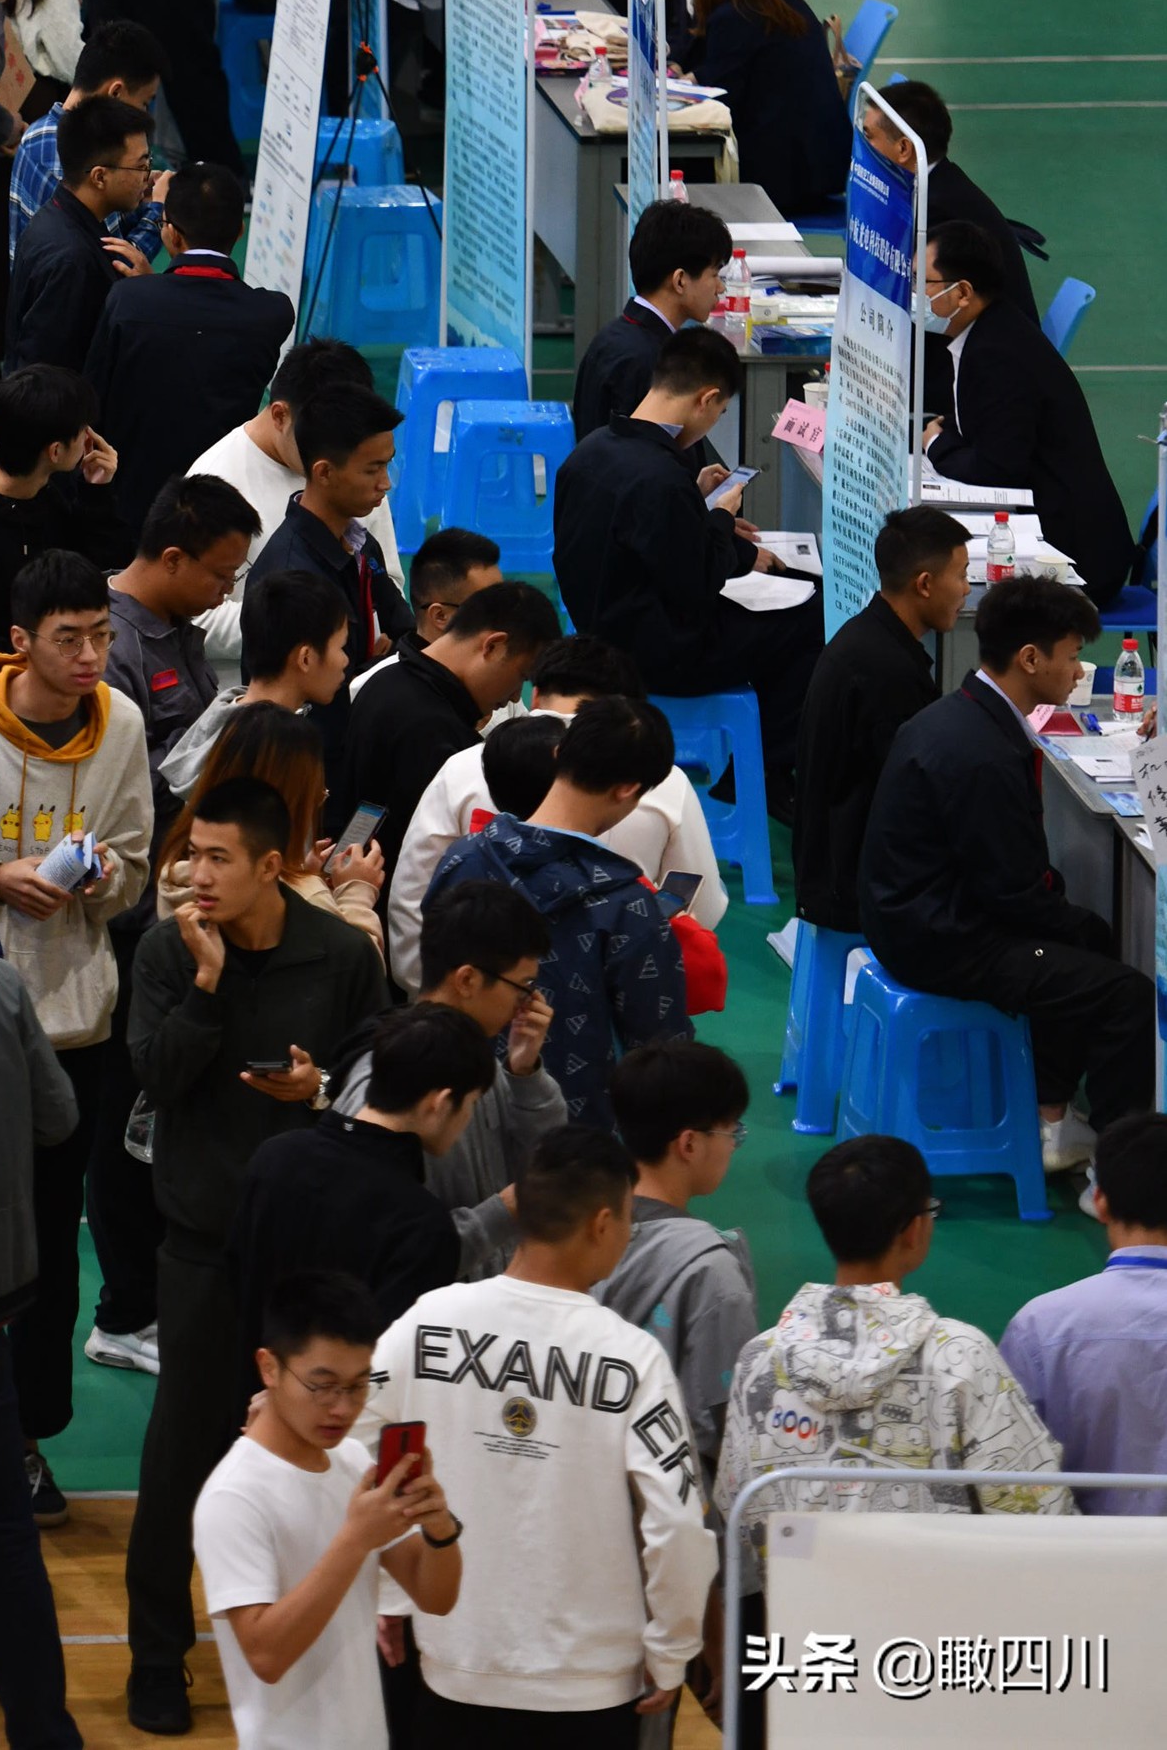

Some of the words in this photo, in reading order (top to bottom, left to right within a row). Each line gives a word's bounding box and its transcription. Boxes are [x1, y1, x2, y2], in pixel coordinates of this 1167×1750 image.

[860, 301, 894, 342] 公司简介
[783, 416, 823, 443] 面试官
[771, 1406, 819, 1449] BOO!
